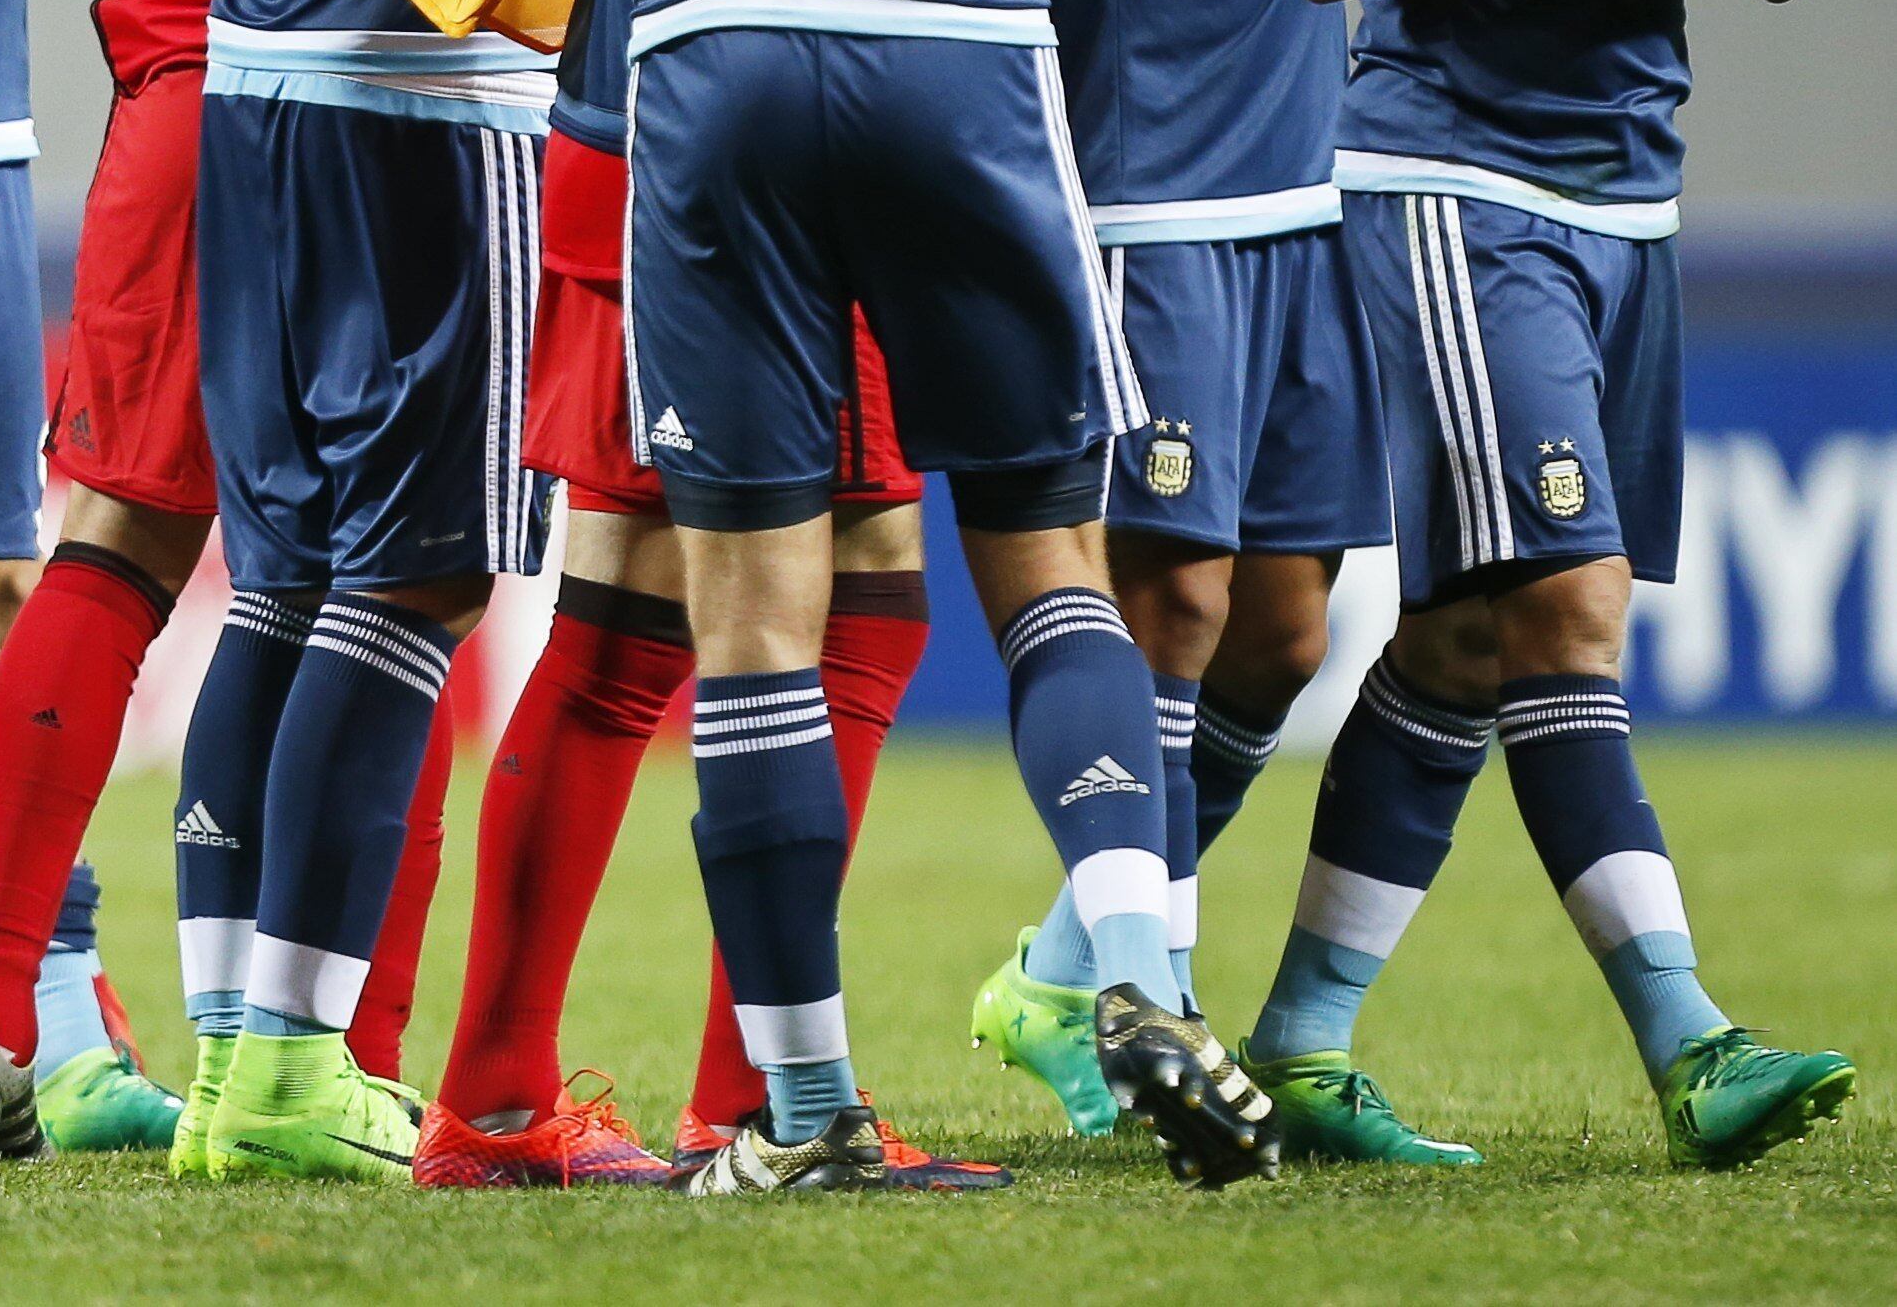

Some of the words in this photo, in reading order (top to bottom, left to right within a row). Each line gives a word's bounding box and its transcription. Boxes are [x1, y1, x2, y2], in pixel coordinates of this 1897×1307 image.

[651, 430, 694, 451] adidas
[1156, 454, 1180, 479] AFA
[1553, 475, 1575, 499] AFA
[1059, 778, 1151, 807] adidas
